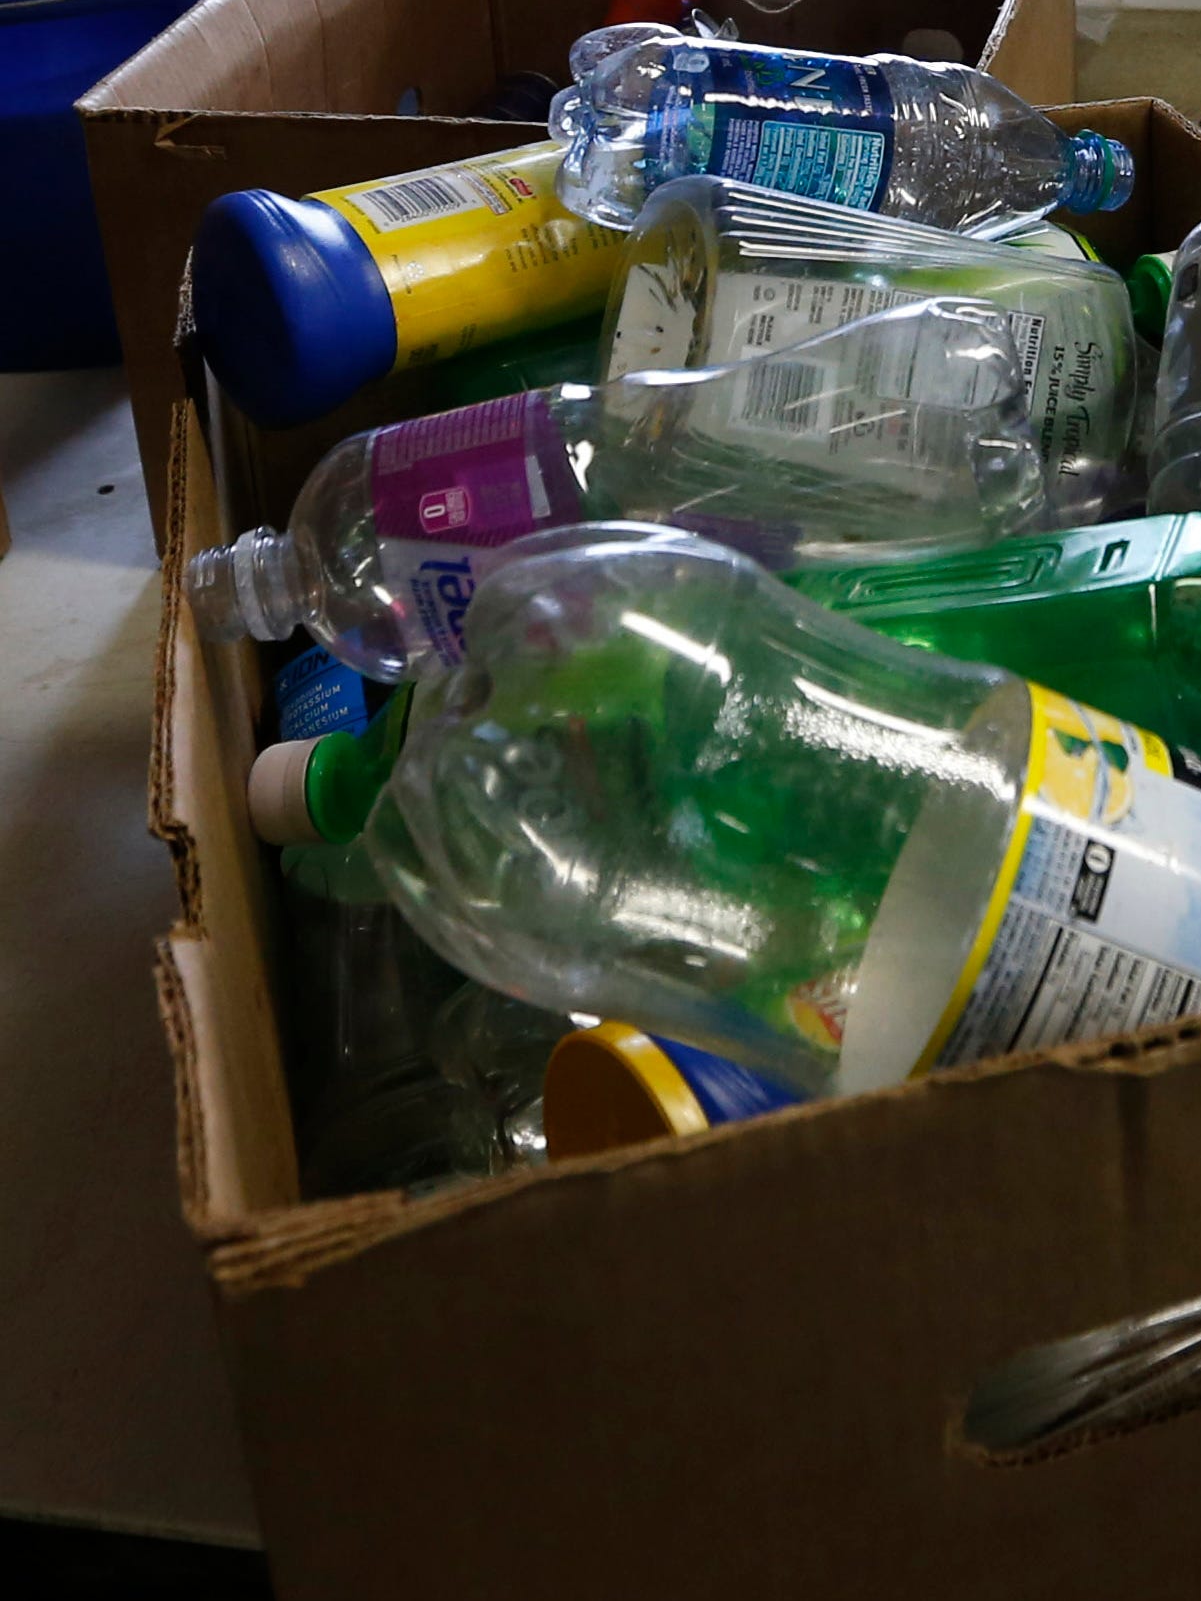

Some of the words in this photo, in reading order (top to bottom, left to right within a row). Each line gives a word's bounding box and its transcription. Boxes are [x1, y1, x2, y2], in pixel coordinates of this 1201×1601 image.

[865, 138, 880, 185] Nutrition
[1025, 318, 1042, 375] Nutrition
[1052, 346, 1065, 374] 15%
[1065, 341, 1102, 401] Simply
[1046, 377, 1060, 415] JUICE
[1059, 406, 1088, 476] Tropical
